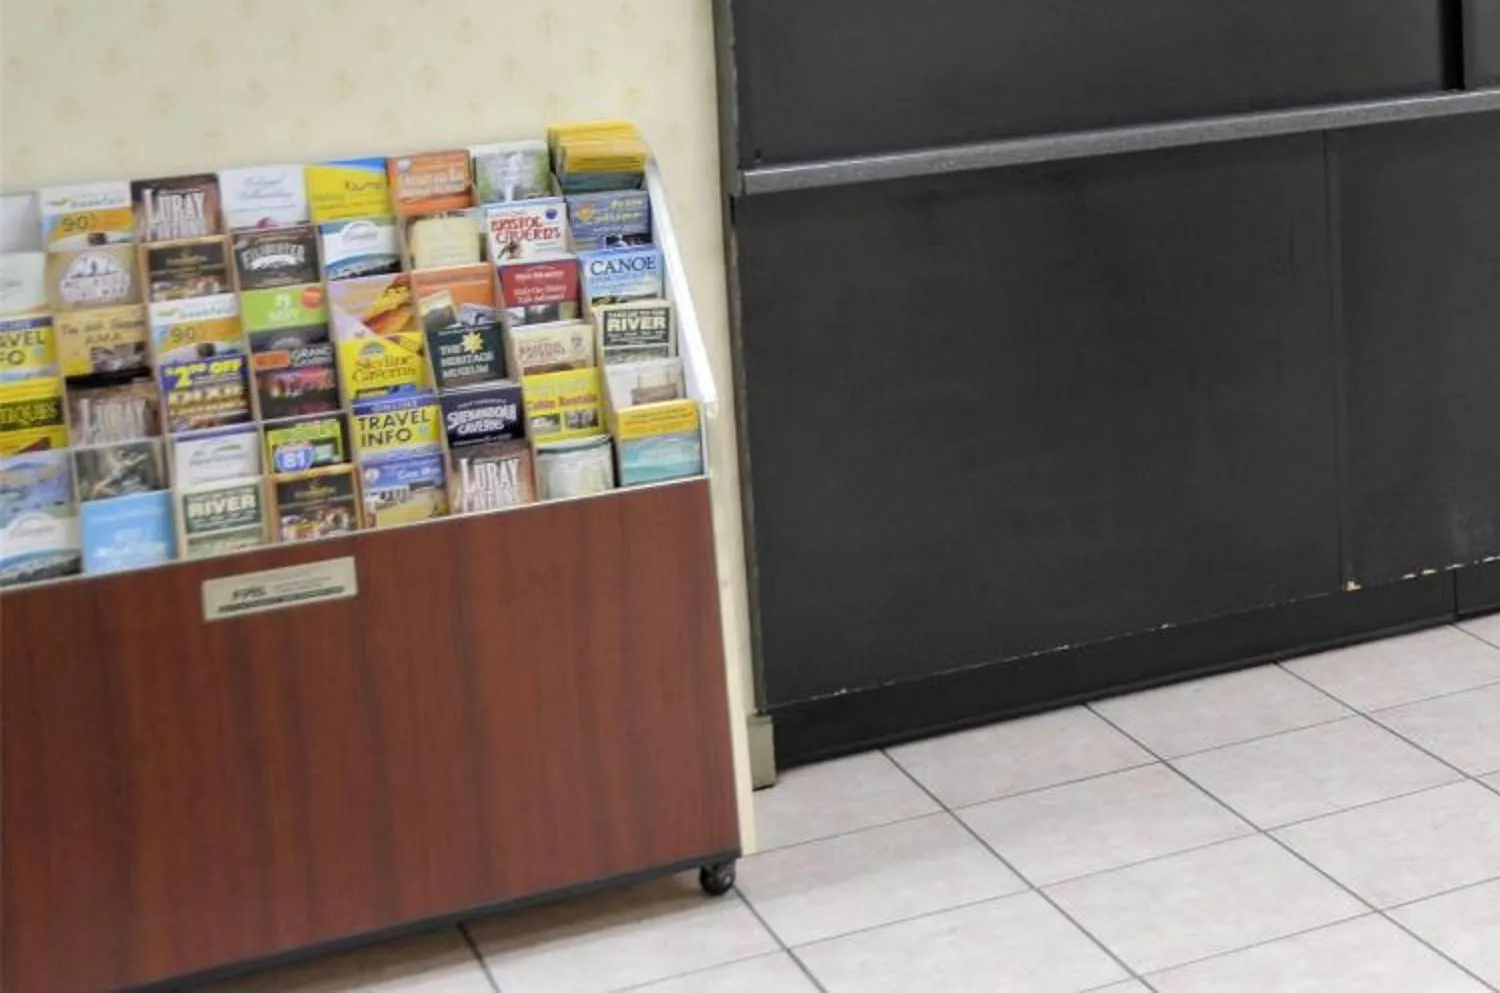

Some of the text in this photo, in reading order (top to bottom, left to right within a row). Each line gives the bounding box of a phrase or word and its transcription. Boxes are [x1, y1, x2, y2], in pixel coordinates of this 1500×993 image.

[590, 256, 657, 276] CANOE
[607, 316, 666, 332] RIVER
[357, 408, 431, 431] TRAVEL
[361, 428, 412, 448] INFO
[188, 494, 255, 516] RIVER
